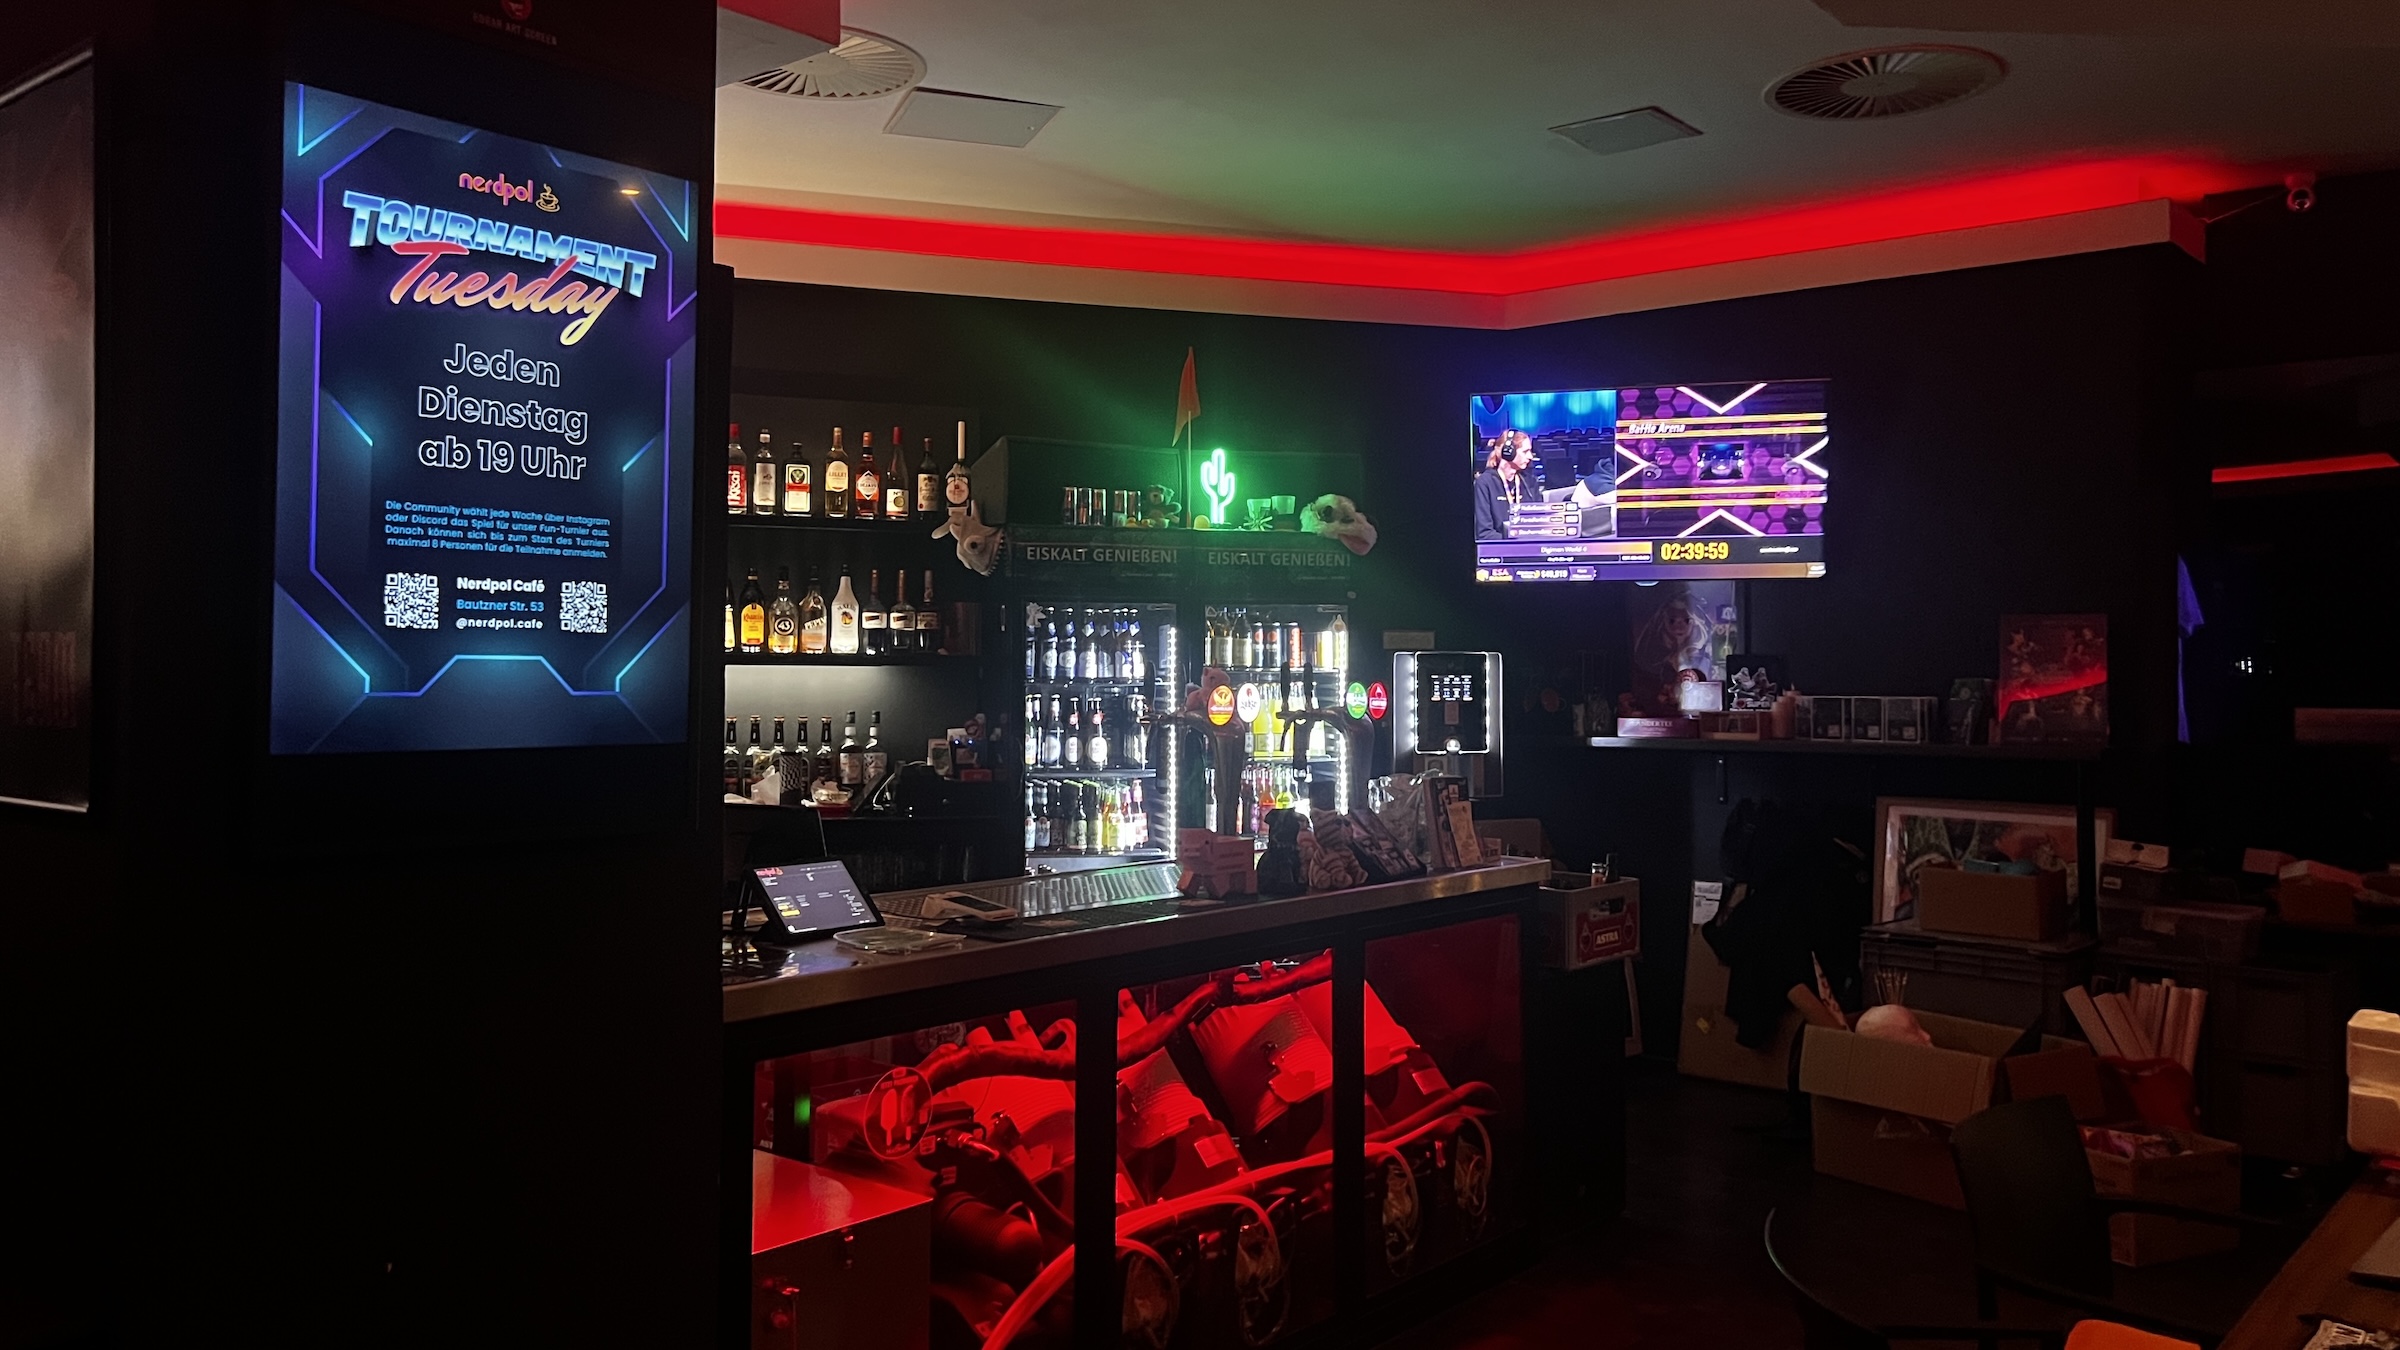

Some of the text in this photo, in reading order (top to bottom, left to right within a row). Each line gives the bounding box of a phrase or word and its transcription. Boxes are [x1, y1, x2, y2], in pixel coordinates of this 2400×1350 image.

[458, 172, 534, 206] nerdpol
[342, 189, 657, 298] TOURNAMENT
[389, 240, 619, 346] Tuesday
[443, 343, 561, 387] Jeden
[417, 385, 589, 446] Dienstag
[418, 435, 587, 480] ab 19 Uhr
[385, 500, 610, 527] Die Community wählt jede Woche über Instagram
[385, 513, 408, 523] oder
[411, 515, 448, 526] Discord
[450, 517, 468, 527] das
[471, 518, 494, 530] Spiel
[496, 520, 509, 530] für
[512, 522, 537, 532] unser
[385, 524, 610, 548] Danach können sich bis zum Start des Turniers
[386, 537, 430, 548] maximal
[439, 540, 483, 552] Personen
[484, 542, 497, 552] für
[498, 543, 513, 553] die
[515, 544, 561, 556] Teilnahme
[1026, 545, 1178, 564] EISKALT GENIEßEN!
[1660, 542, 1729, 561] 02:39:59
[1208, 551, 1351, 567] EISKALT GENIEßEN!
[456, 576, 545, 594] Nerdpol Café
[455, 599, 544, 612] Bautzner Str. 53
[455, 617, 544, 630] @nerdpol.cafe
[777, 621, 790, 630] 43
[1595, 930, 1619, 945] ASTRA
